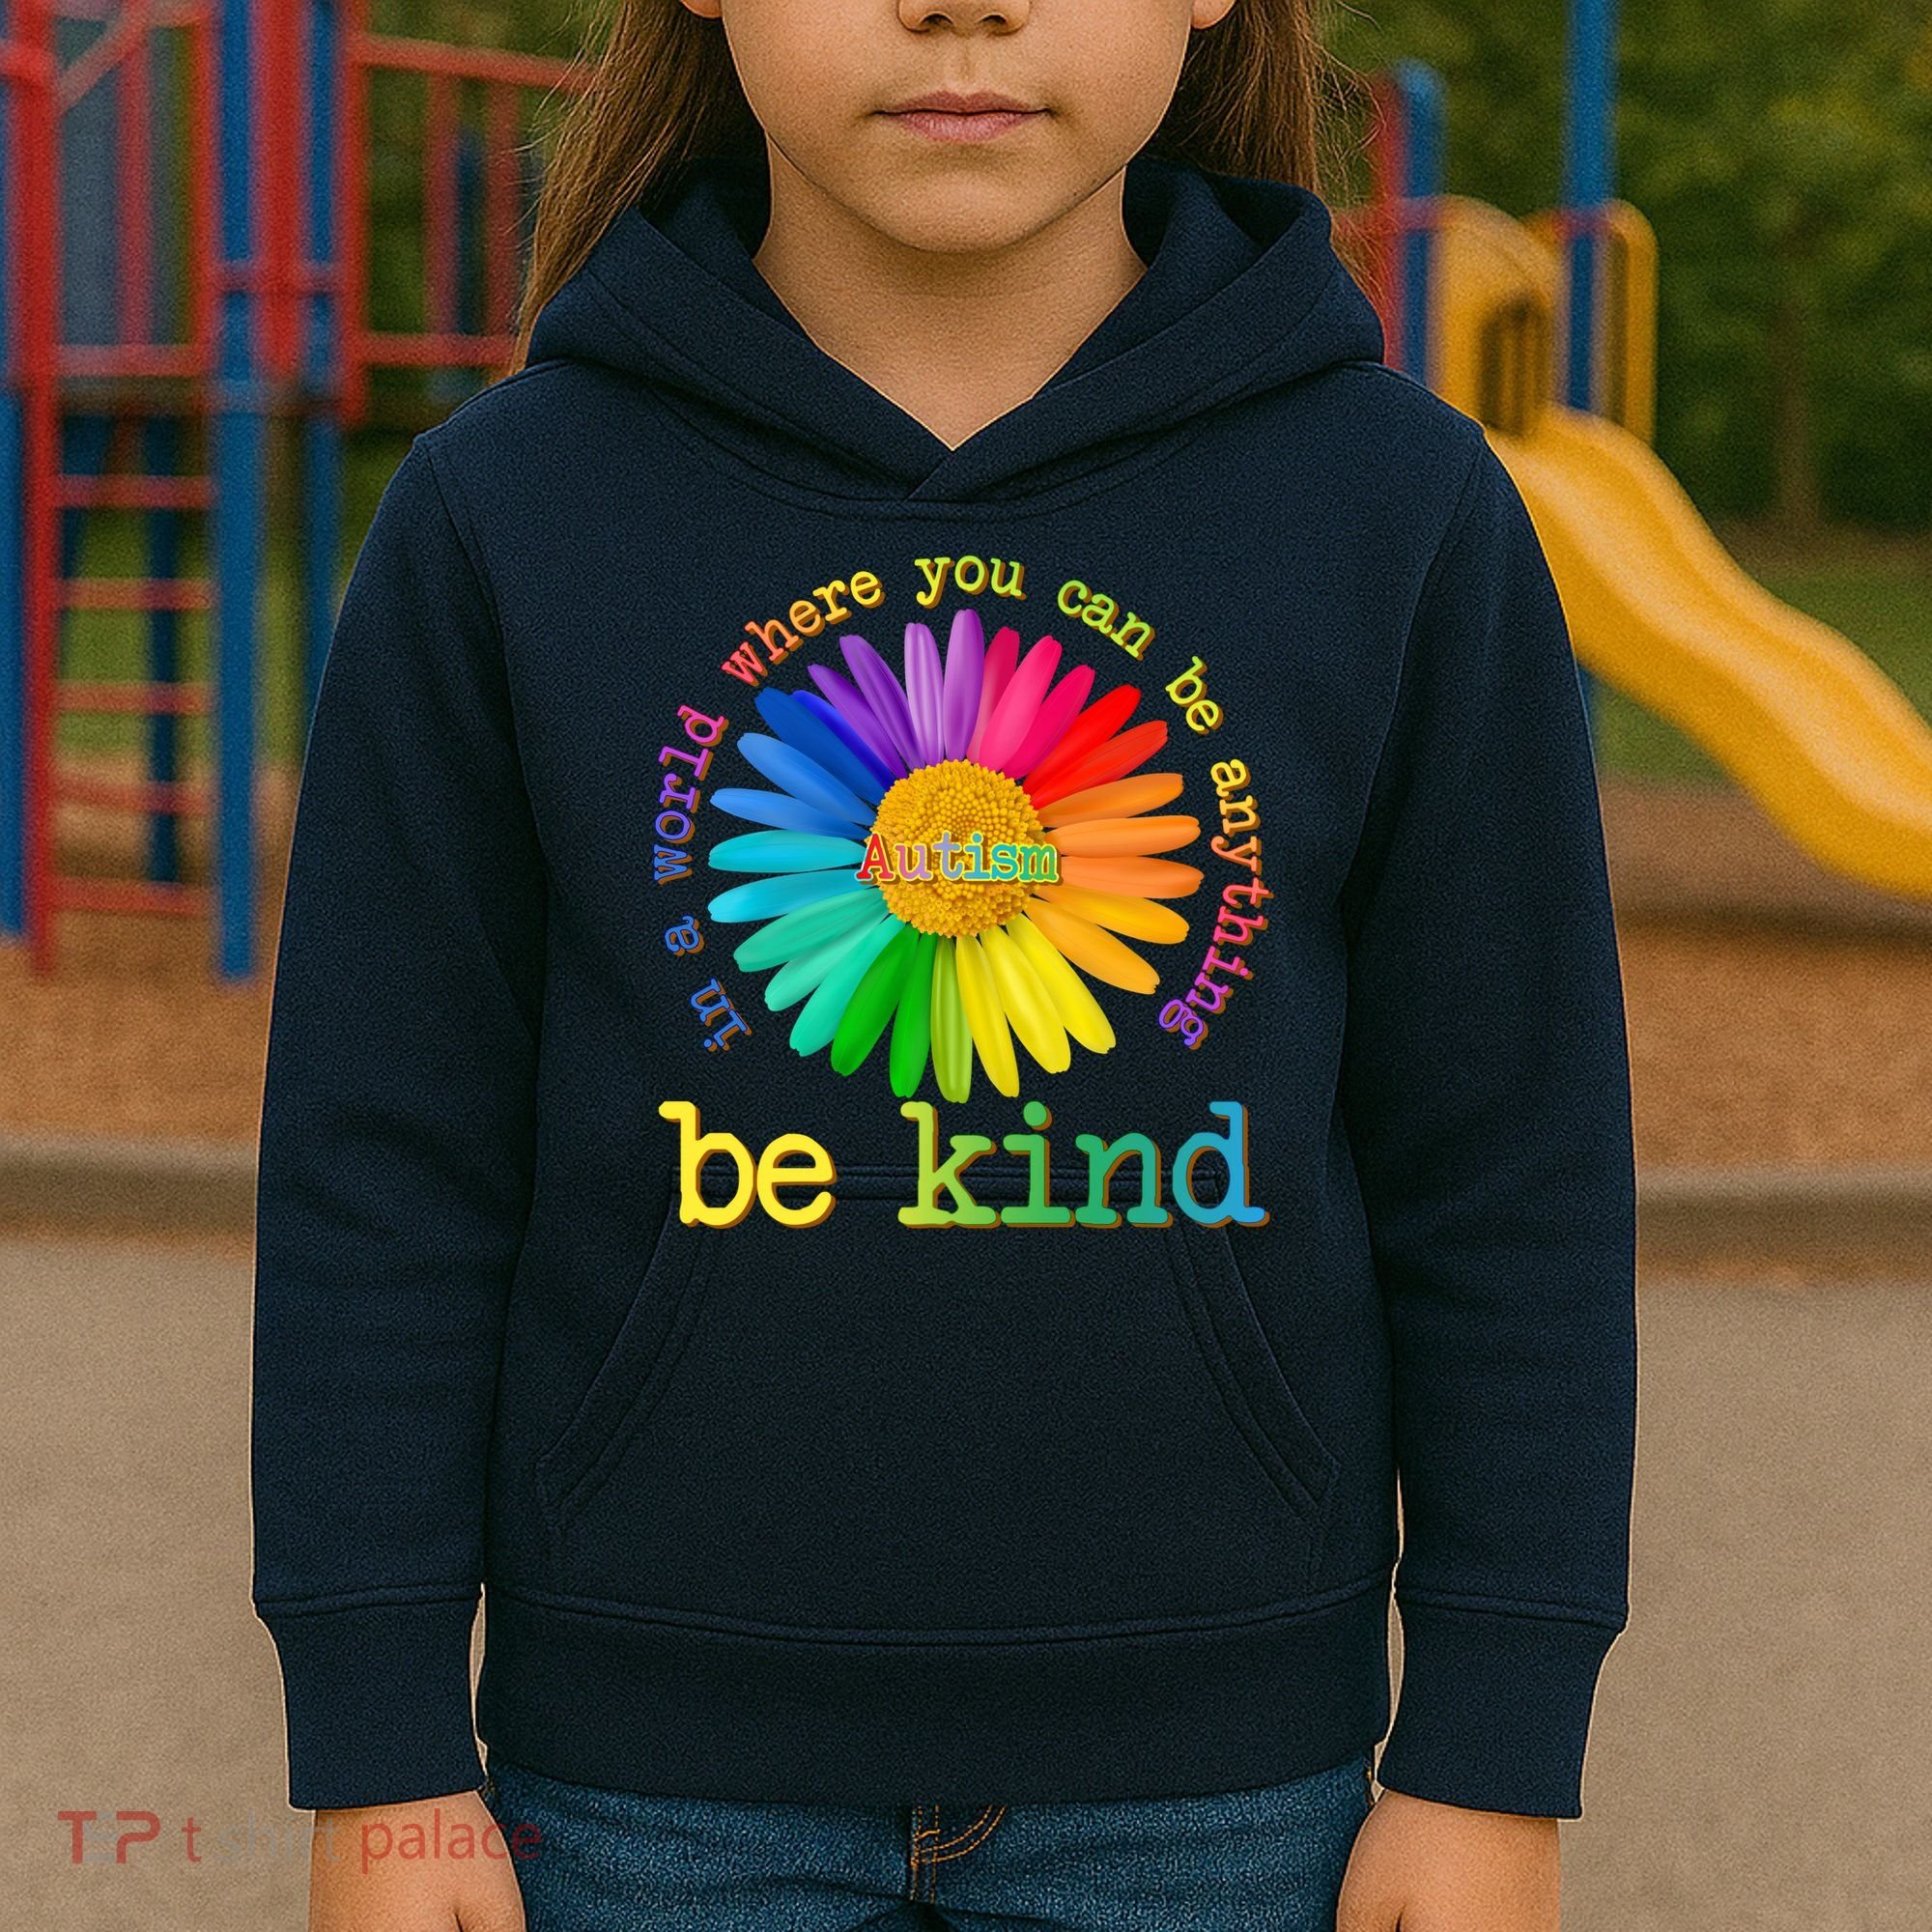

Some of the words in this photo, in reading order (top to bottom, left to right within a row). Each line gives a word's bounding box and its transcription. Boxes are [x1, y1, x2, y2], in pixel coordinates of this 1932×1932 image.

[914, 554, 1026, 608] you
[1057, 580, 1156, 661] can
[722, 570, 883, 687] where
[1166, 656, 1223, 734] be
[653, 704, 727, 883] world
[855, 833, 1063, 886] Autism
[664, 915, 703, 954] a
[1159, 758, 1271, 1050] anything
[689, 978, 752, 1051] in
[658, 1100, 838, 1229] be
[897, 1100, 1270, 1229] kind
